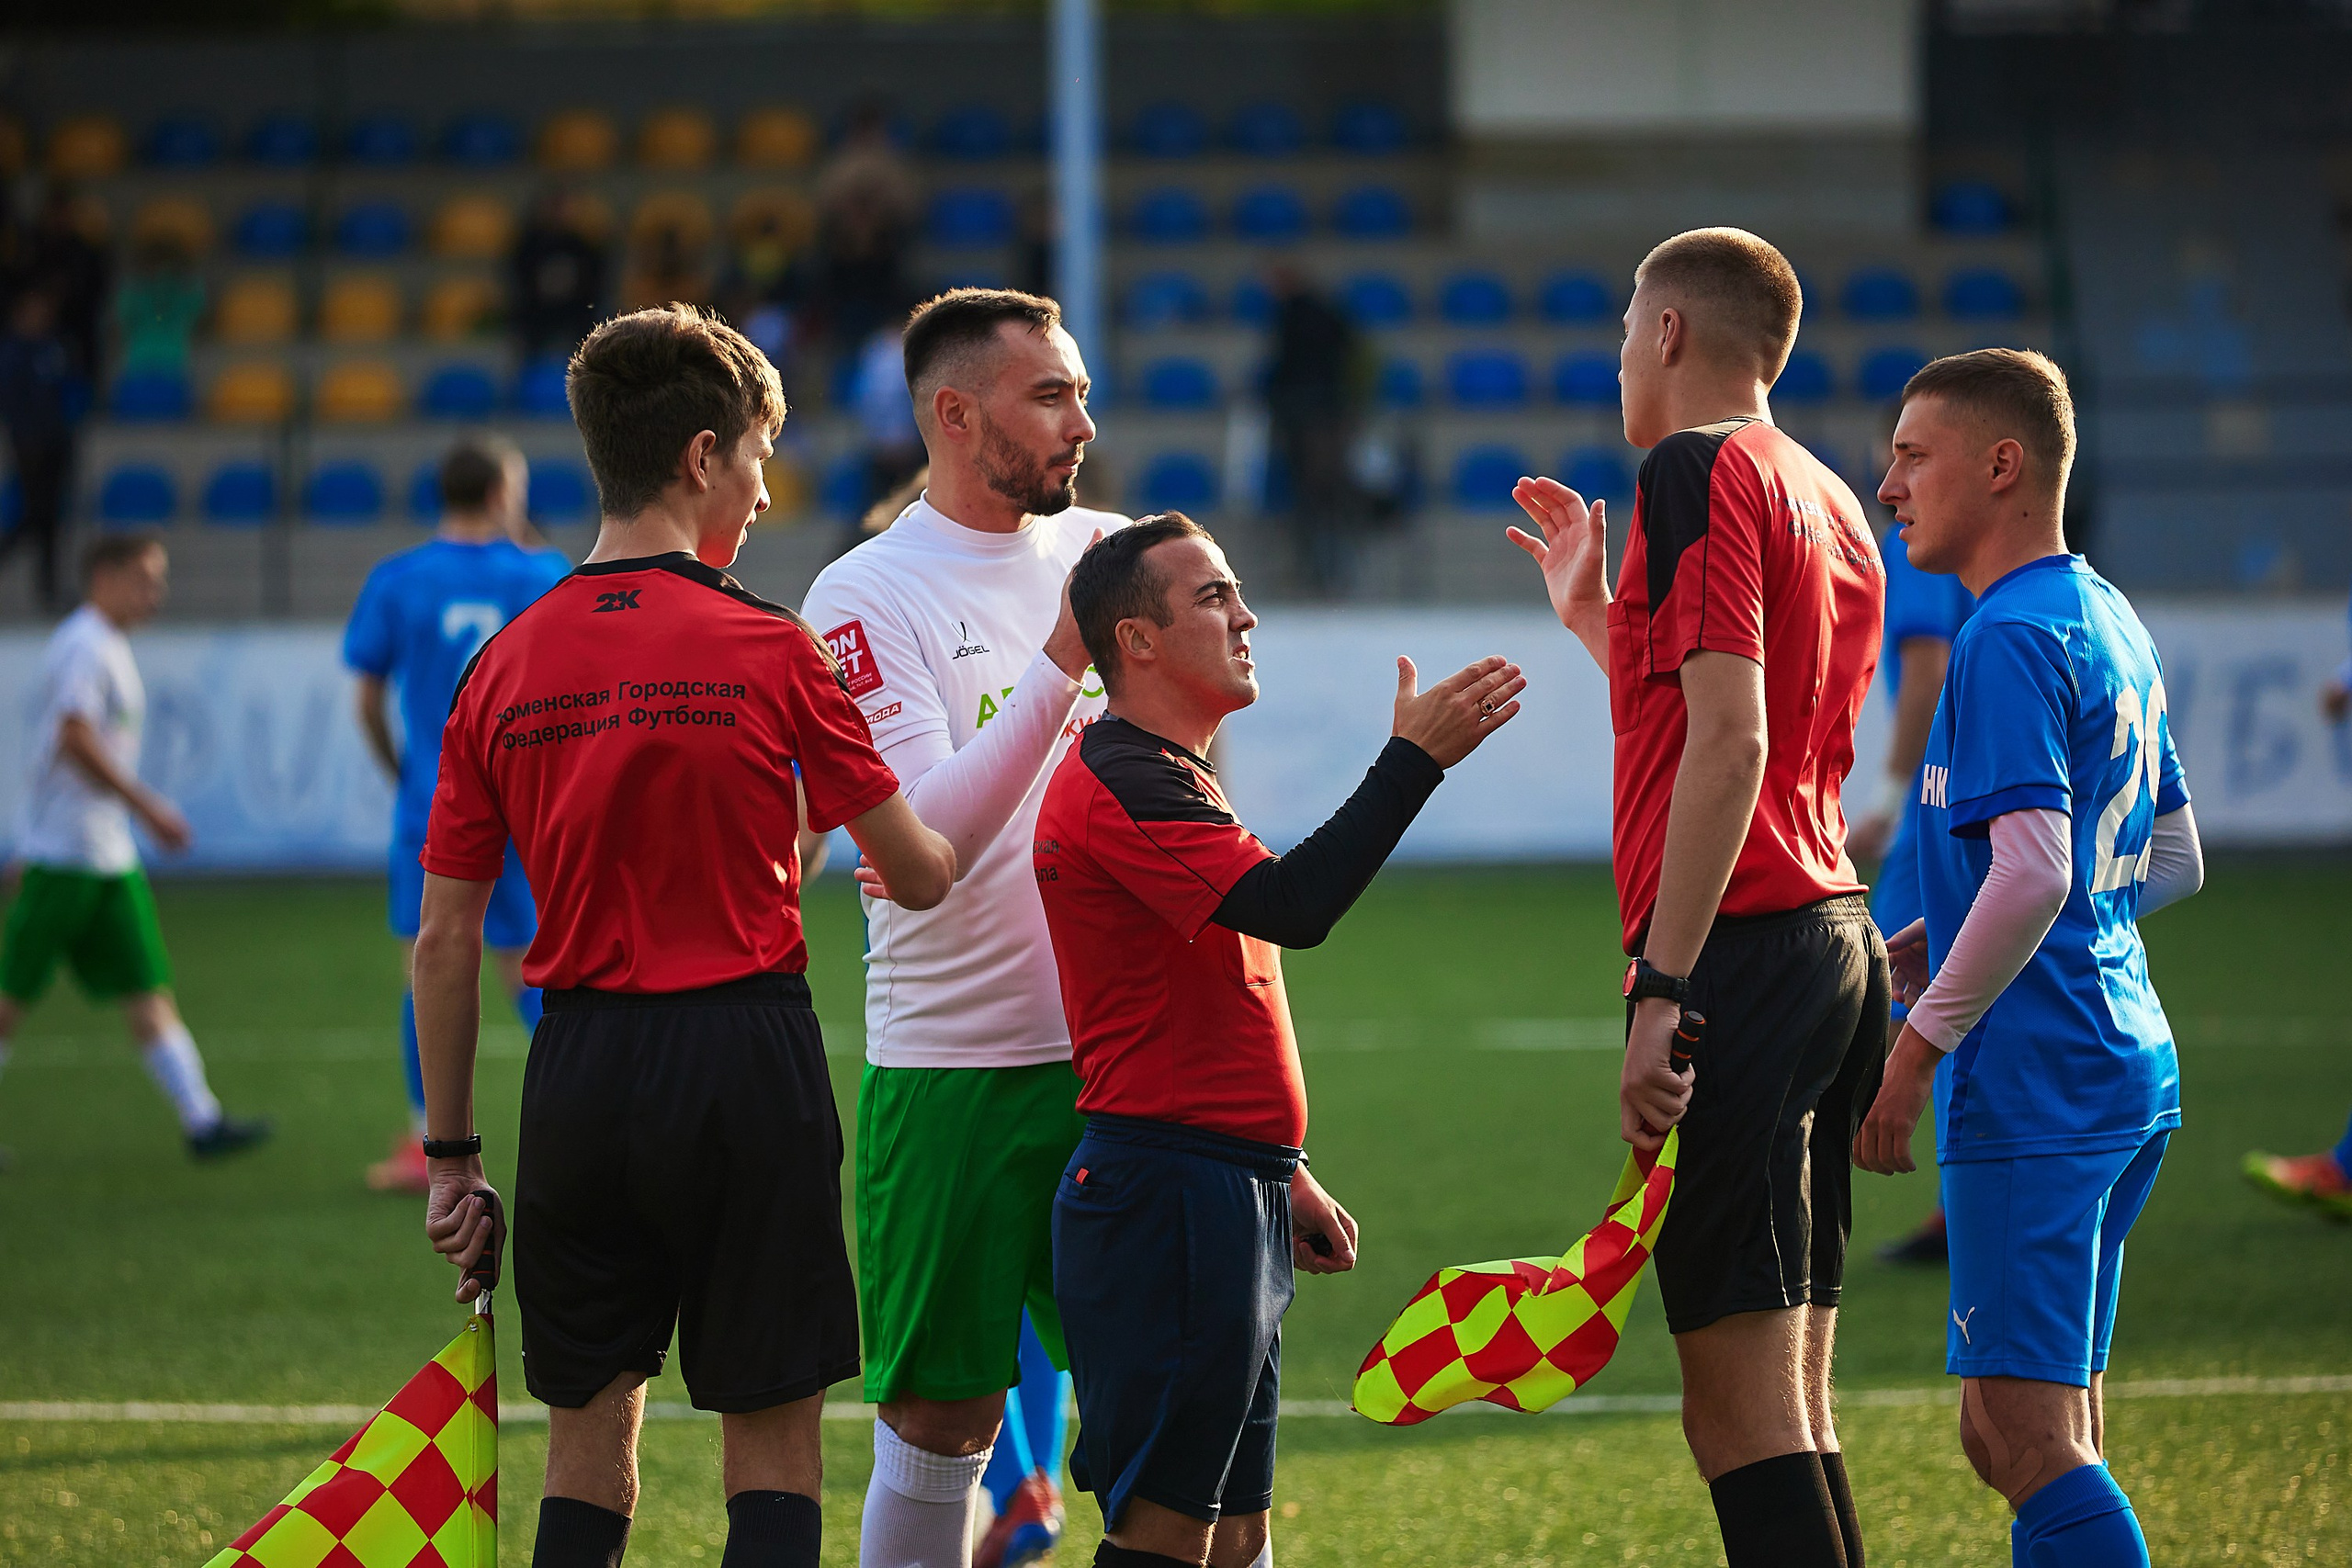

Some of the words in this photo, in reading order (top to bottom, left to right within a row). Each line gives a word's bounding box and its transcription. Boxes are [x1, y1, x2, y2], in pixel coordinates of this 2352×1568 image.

[591, 589, 642, 613] 2K
[952, 645, 990, 660] JÖGEL
[618, 681, 745, 702] Городская
[503, 714, 619, 750] Федерация
[628, 705, 736, 730] Футбола
